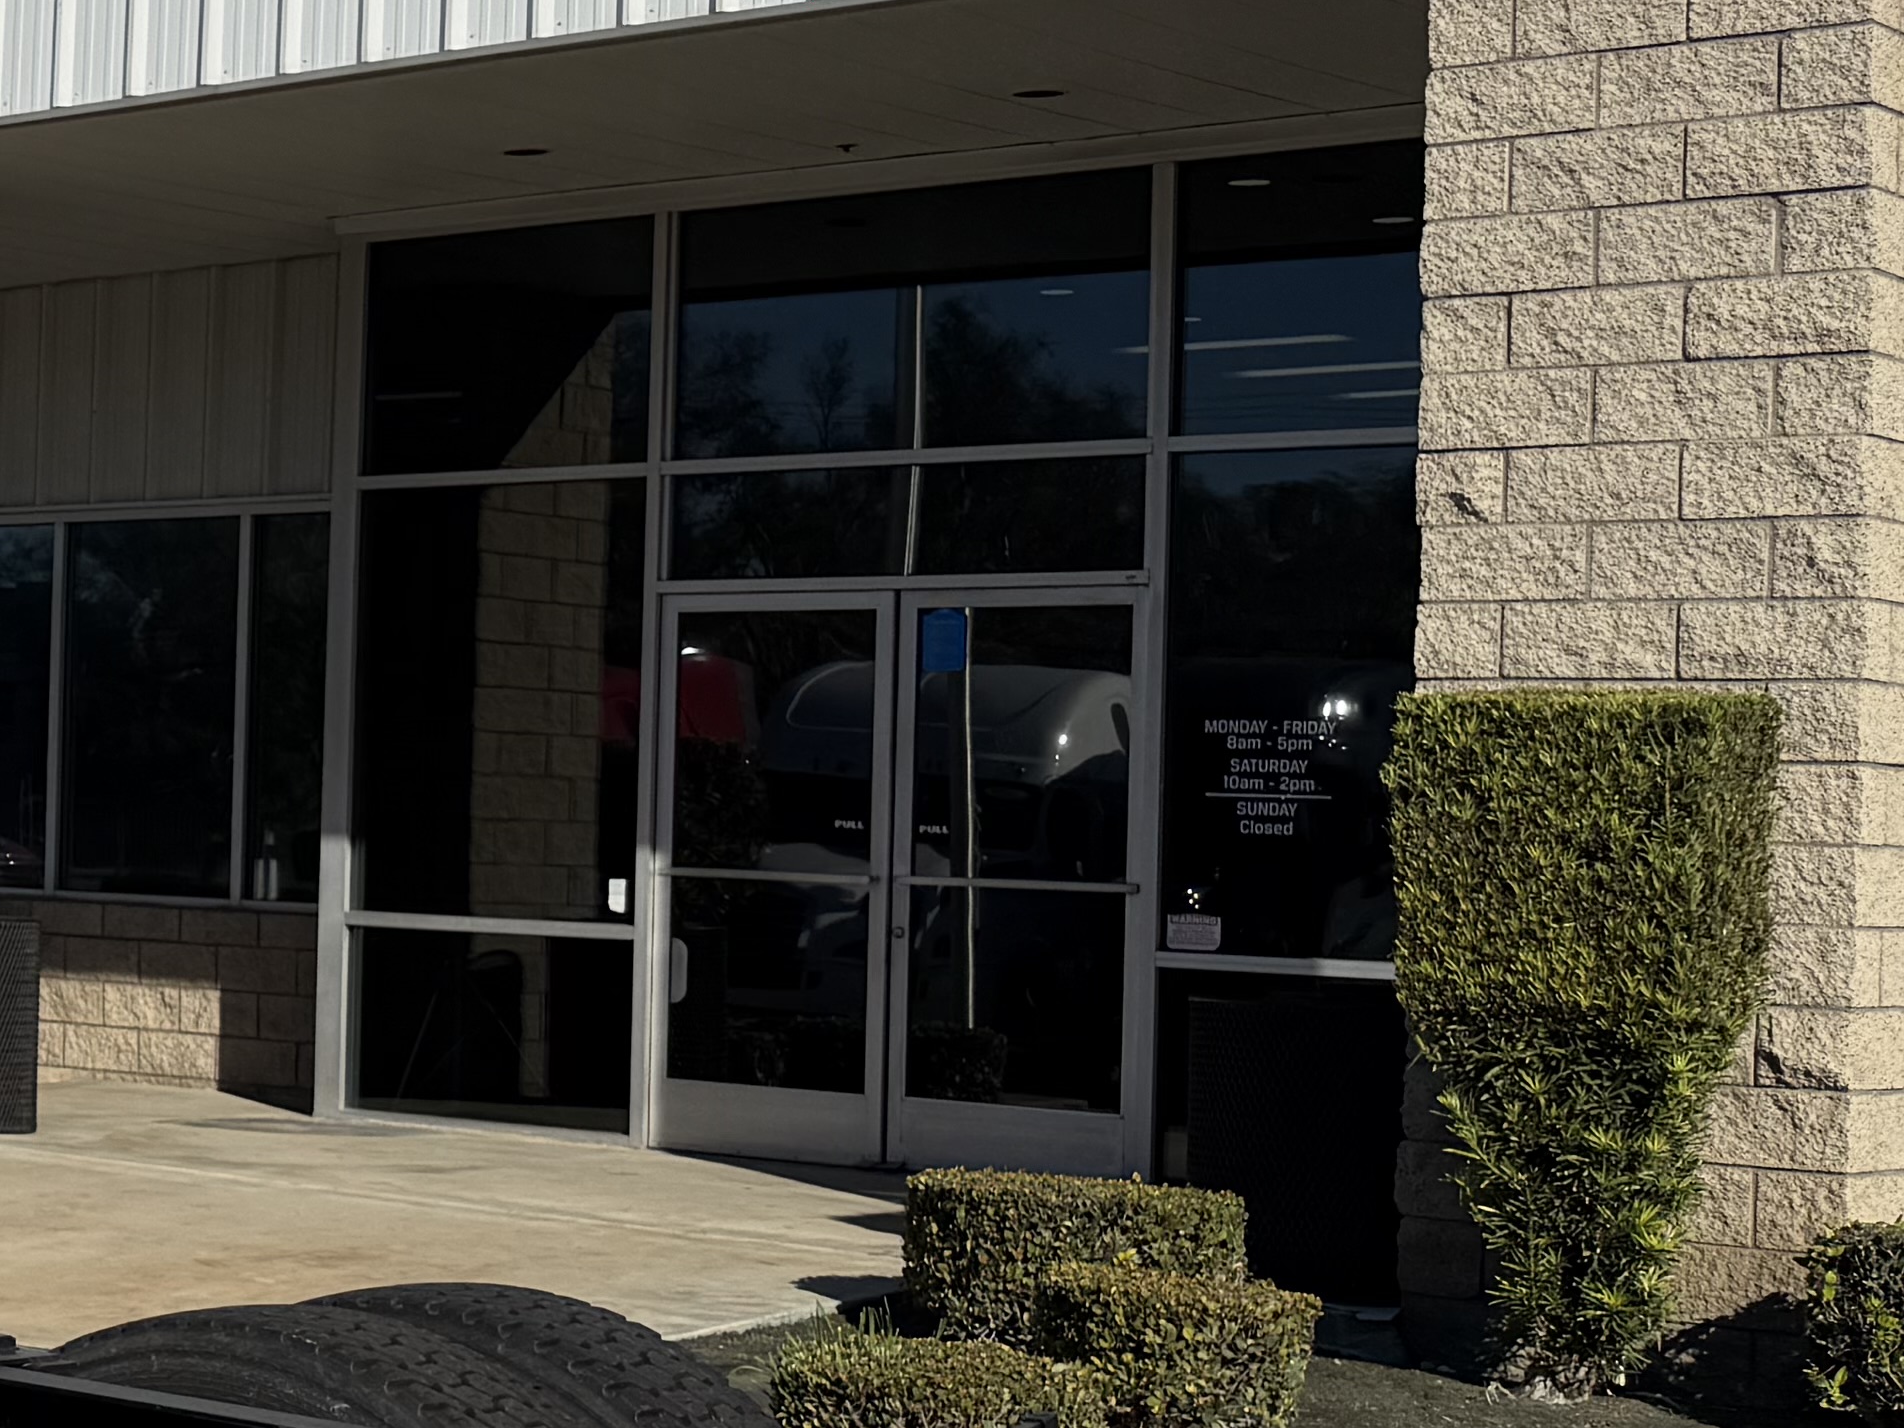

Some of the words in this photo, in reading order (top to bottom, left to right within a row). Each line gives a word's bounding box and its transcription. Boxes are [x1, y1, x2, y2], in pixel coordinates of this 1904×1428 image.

[1204, 719, 1268, 735] MONDAY
[1283, 720, 1337, 736] FRIDAY
[1226, 735, 1262, 750] 8am
[1277, 736, 1313, 752] 5pm
[1230, 758, 1309, 775] SATURDAY
[1223, 774, 1264, 791] 10am
[1280, 776, 1315, 794] 2pm
[1236, 801, 1298, 818] SUNDAY
[834, 819, 865, 830] PULL
[918, 825, 950, 834] PULL
[1240, 821, 1293, 837] Closed
[1170, 914, 1217, 926] WARNING
